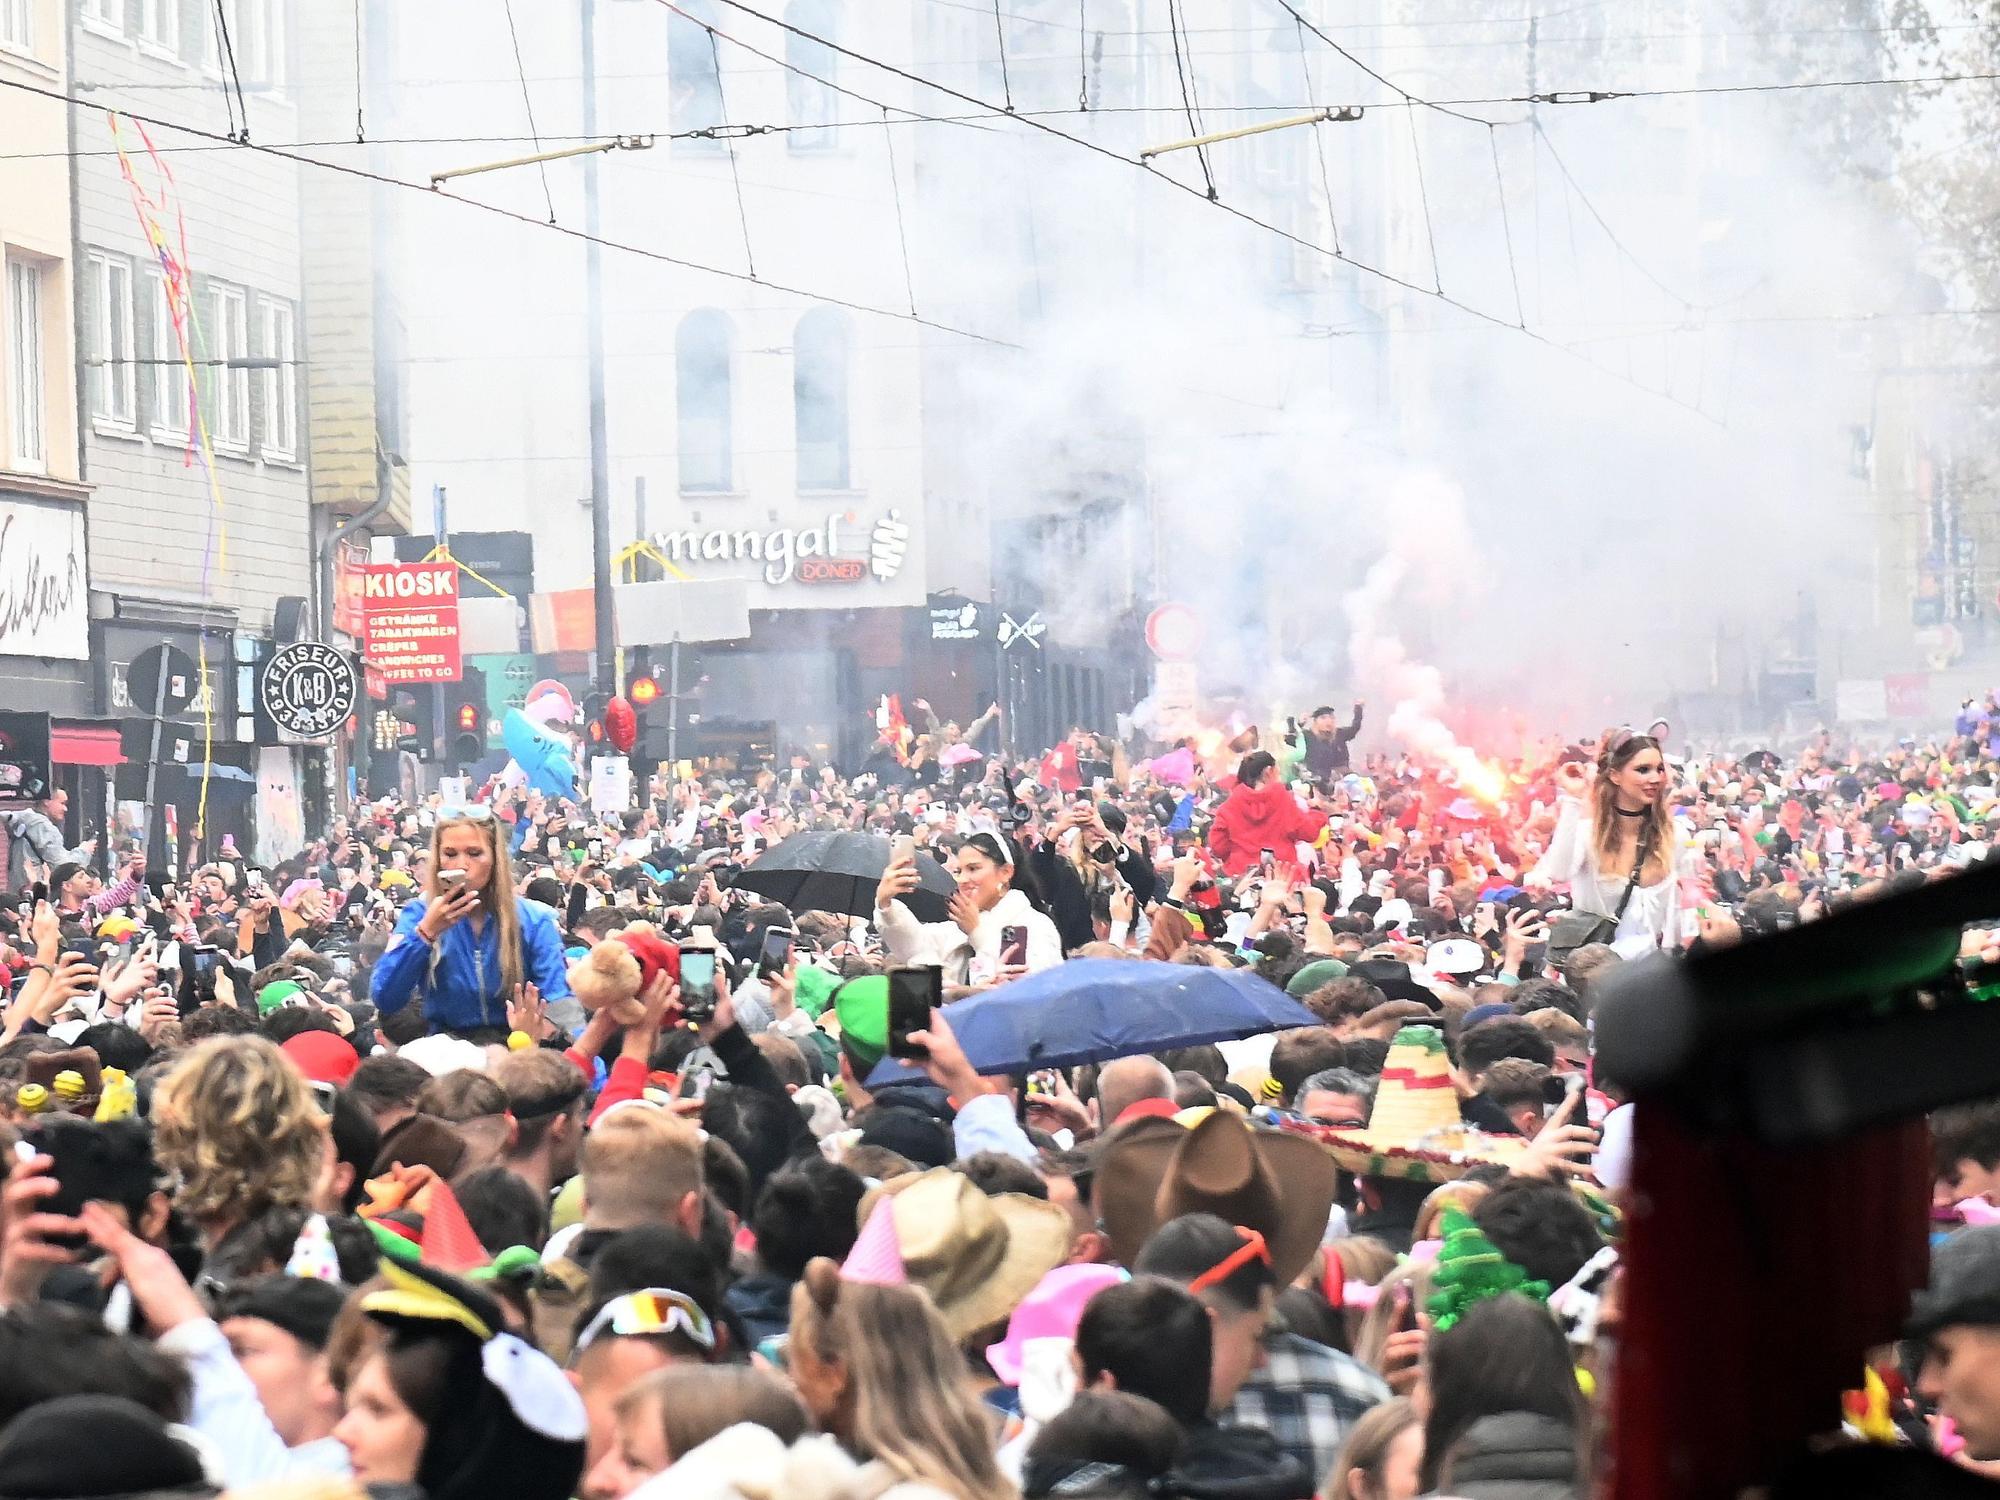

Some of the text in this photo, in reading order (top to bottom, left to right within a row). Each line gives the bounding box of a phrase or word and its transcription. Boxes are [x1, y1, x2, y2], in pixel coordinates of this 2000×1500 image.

[654, 512, 844, 585] mangal
[364, 570, 455, 598] KIOSK
[269, 645, 348, 683] FRISEUR
[373, 654, 445, 665] ANDWICHES
[418, 667, 433, 678] TO
[435, 667, 454, 677] GO
[292, 672, 326, 706] K&B
